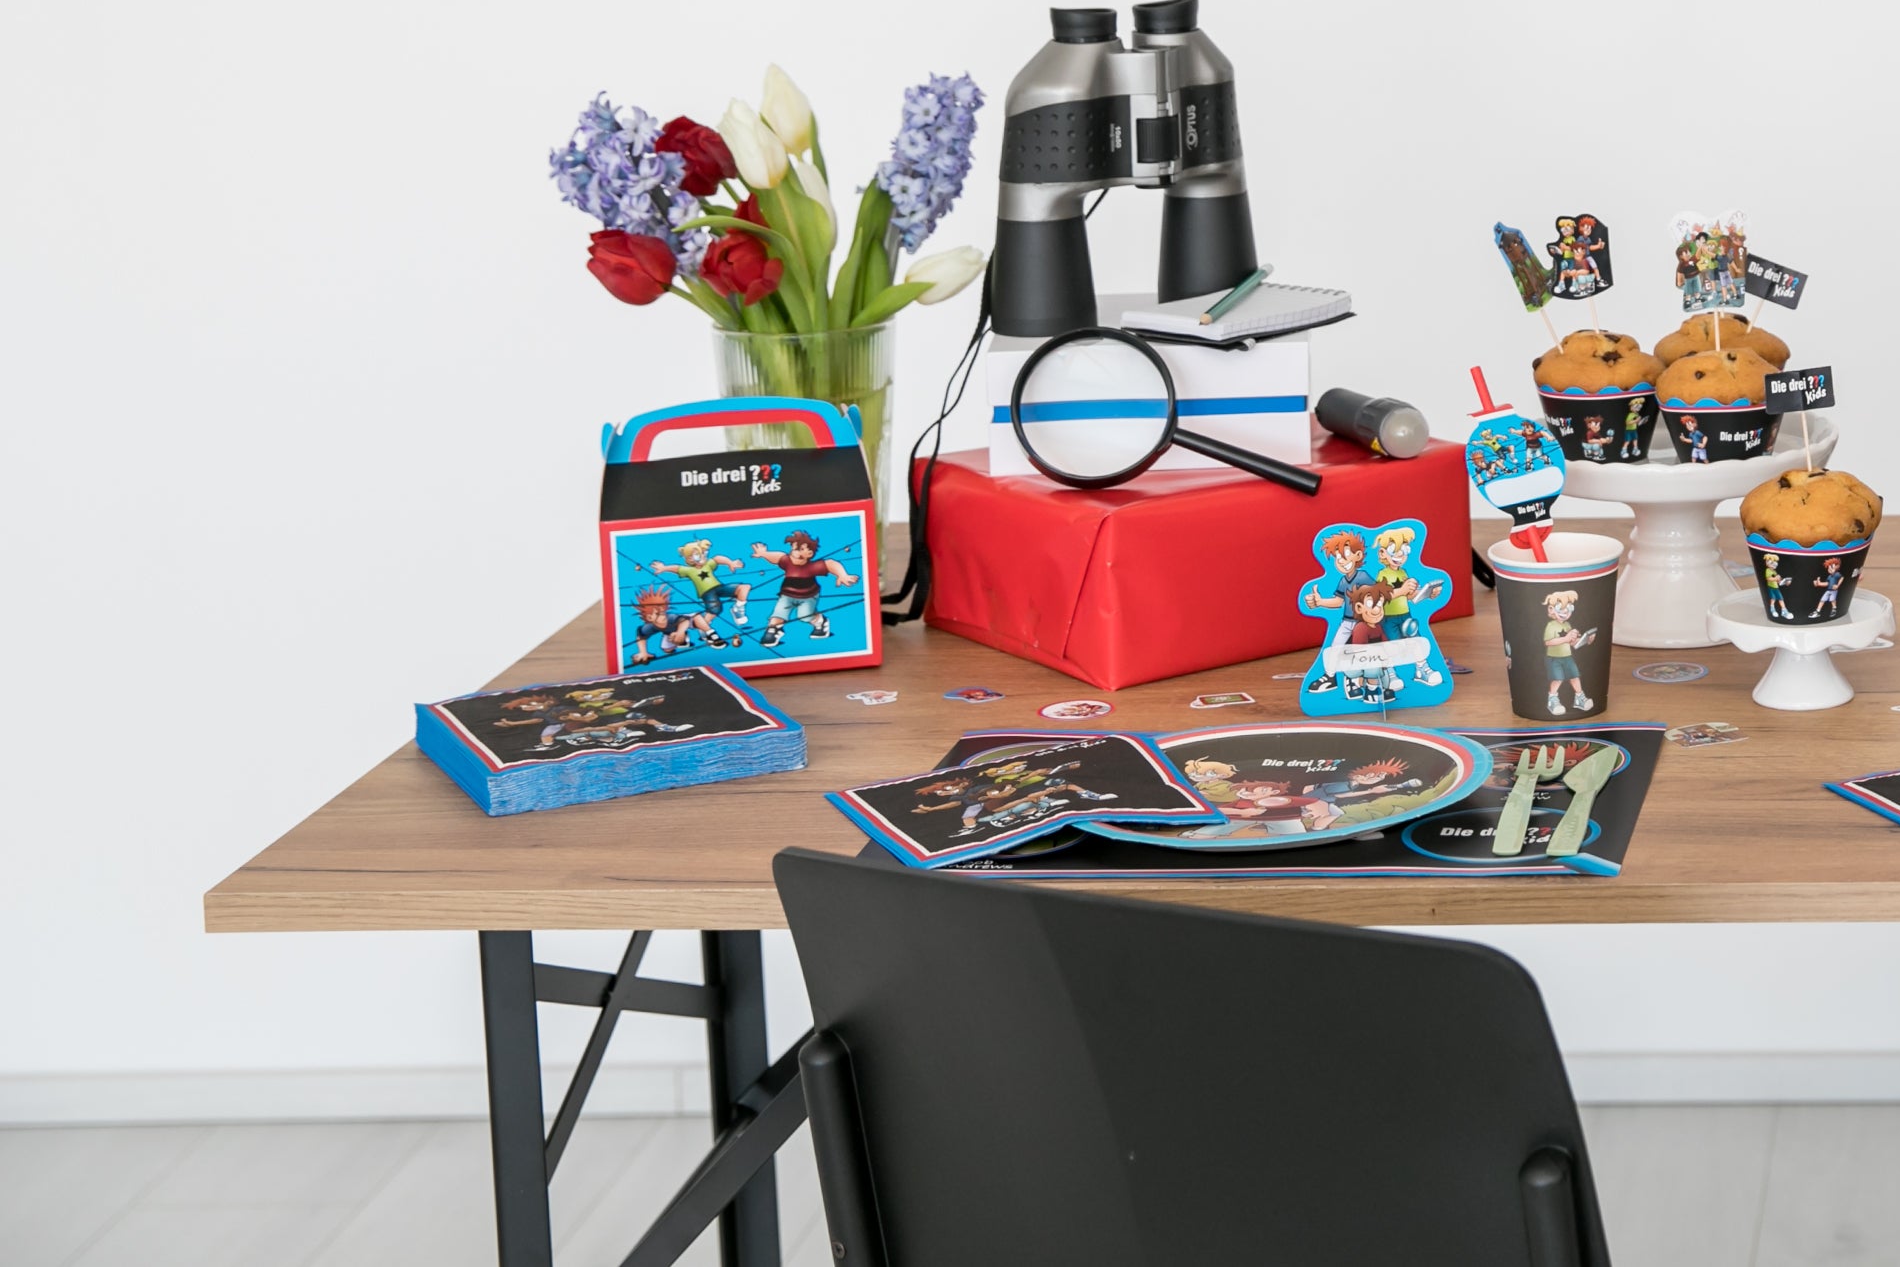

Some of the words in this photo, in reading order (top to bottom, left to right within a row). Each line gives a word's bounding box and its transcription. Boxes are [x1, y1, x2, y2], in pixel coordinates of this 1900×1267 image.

[1186, 105, 1198, 150] OPTUS
[1748, 261, 1764, 276] Die
[1763, 268, 1782, 283] drei
[1771, 380, 1787, 394] Die
[1789, 377, 1807, 392] drei
[1805, 386, 1827, 405] Kids
[681, 470, 709, 487] Die
[711, 466, 746, 484] drei
[751, 478, 782, 496] Kids
[1344, 650, 1385, 665] Tom
[1440, 827, 1474, 836] Die
